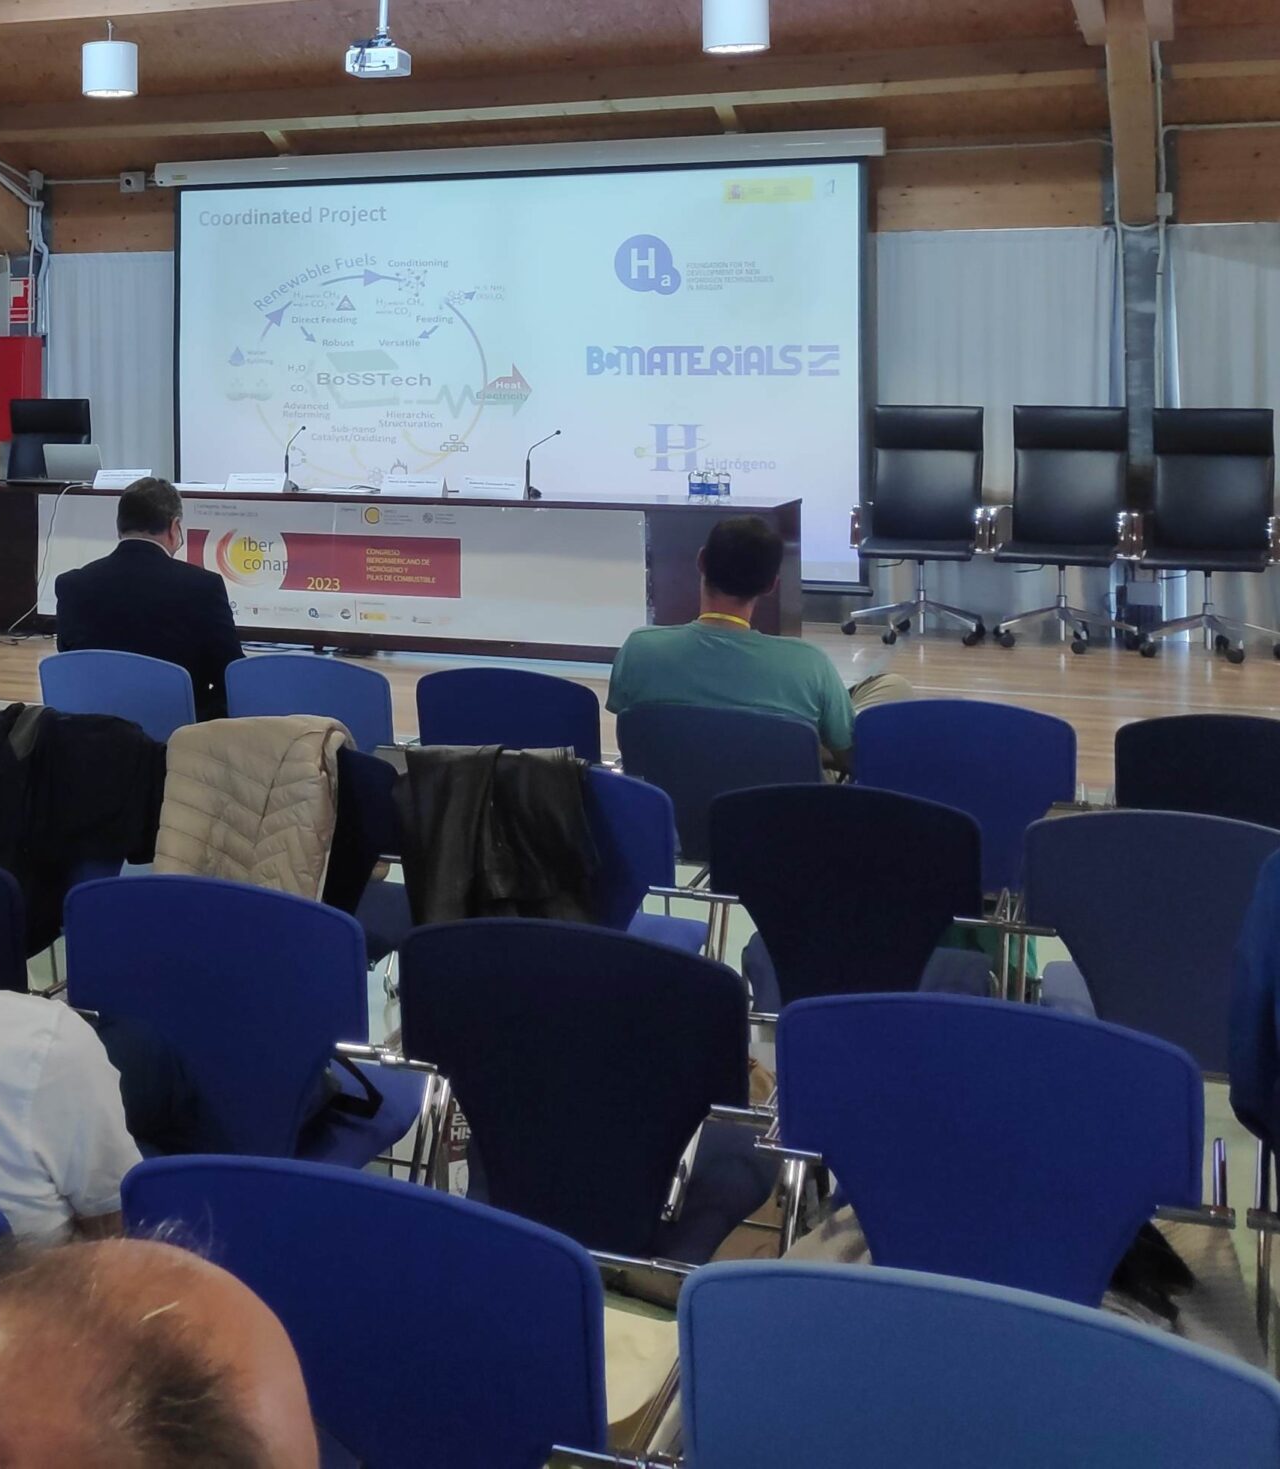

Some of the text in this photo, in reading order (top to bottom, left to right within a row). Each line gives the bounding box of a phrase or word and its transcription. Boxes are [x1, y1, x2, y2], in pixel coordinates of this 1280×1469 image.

[199, 205, 387, 226] Coordinated Project
[388, 259, 449, 269] Conditioning
[253, 253, 377, 311] Renewable Fuels
[291, 315, 357, 325] Direct Feeding
[416, 315, 454, 325] Feeding
[322, 339, 354, 347] Robust
[379, 338, 420, 347] Versatile
[316, 373, 431, 387] BoSSTech
[496, 381, 521, 390] Heat
[476, 391, 529, 401] Electricity
[283, 402, 329, 410] Advanced
[386, 410, 435, 419] Hierarchic
[378, 419, 443, 429] Structuration
[330, 425, 376, 434] Sub-nano
[704, 458, 777, 473] Hidrógeno
[243, 537, 274, 552] iber
[307, 577, 340, 591] 2023
[393, 575, 436, 583] COMBUSTIBLE
